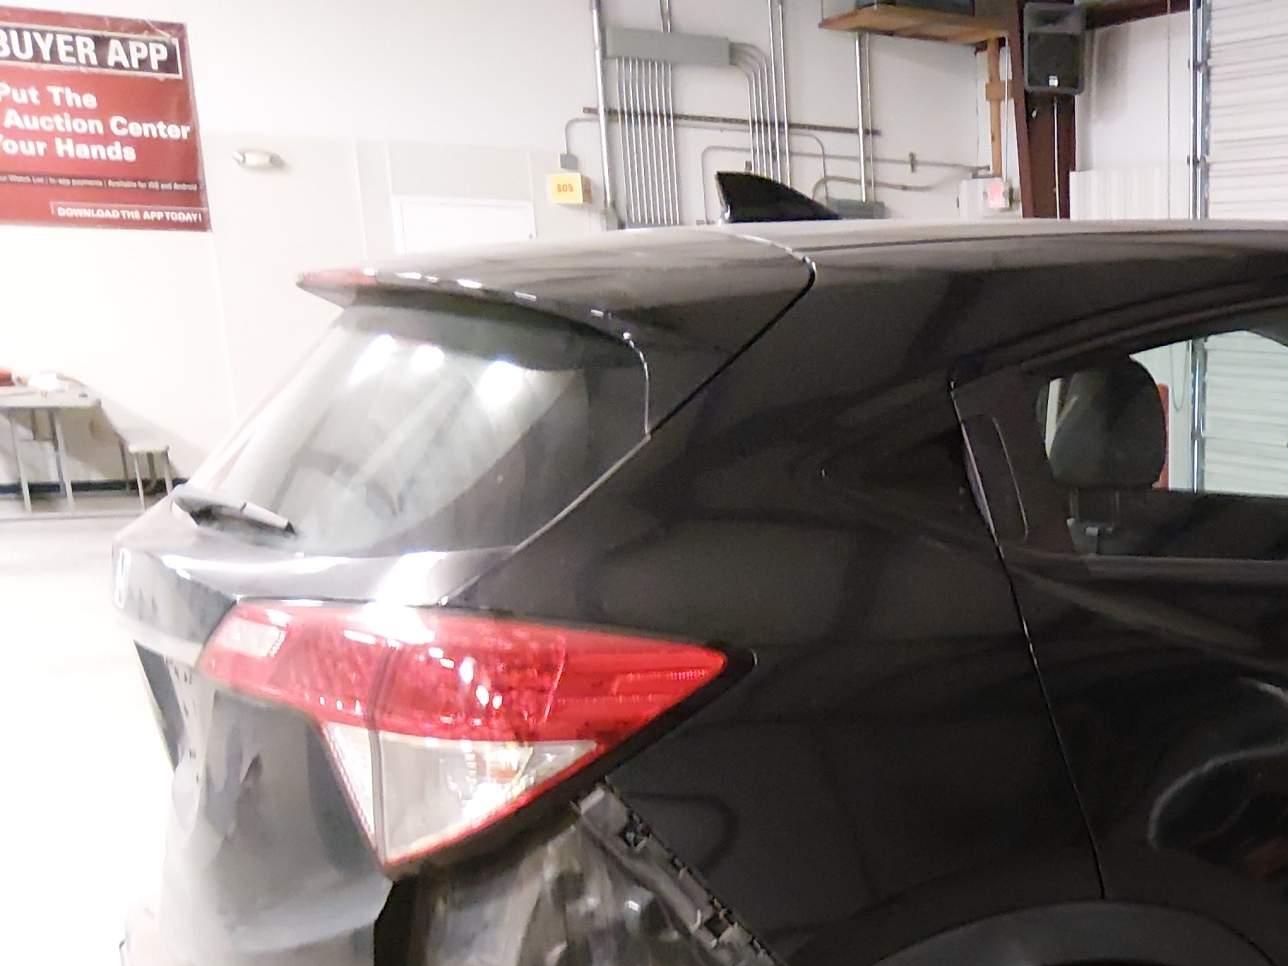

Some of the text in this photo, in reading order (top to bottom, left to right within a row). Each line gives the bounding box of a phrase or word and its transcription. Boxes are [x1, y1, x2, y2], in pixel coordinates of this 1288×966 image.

[107, 38, 168, 71] APP
[46, 86, 98, 109] The
[3, 108, 191, 140] Auction Center
[0, 134, 137, 162] our Hands
[57, 206, 119, 219] DOWNLOAD
[143, 210, 163, 221] APP
